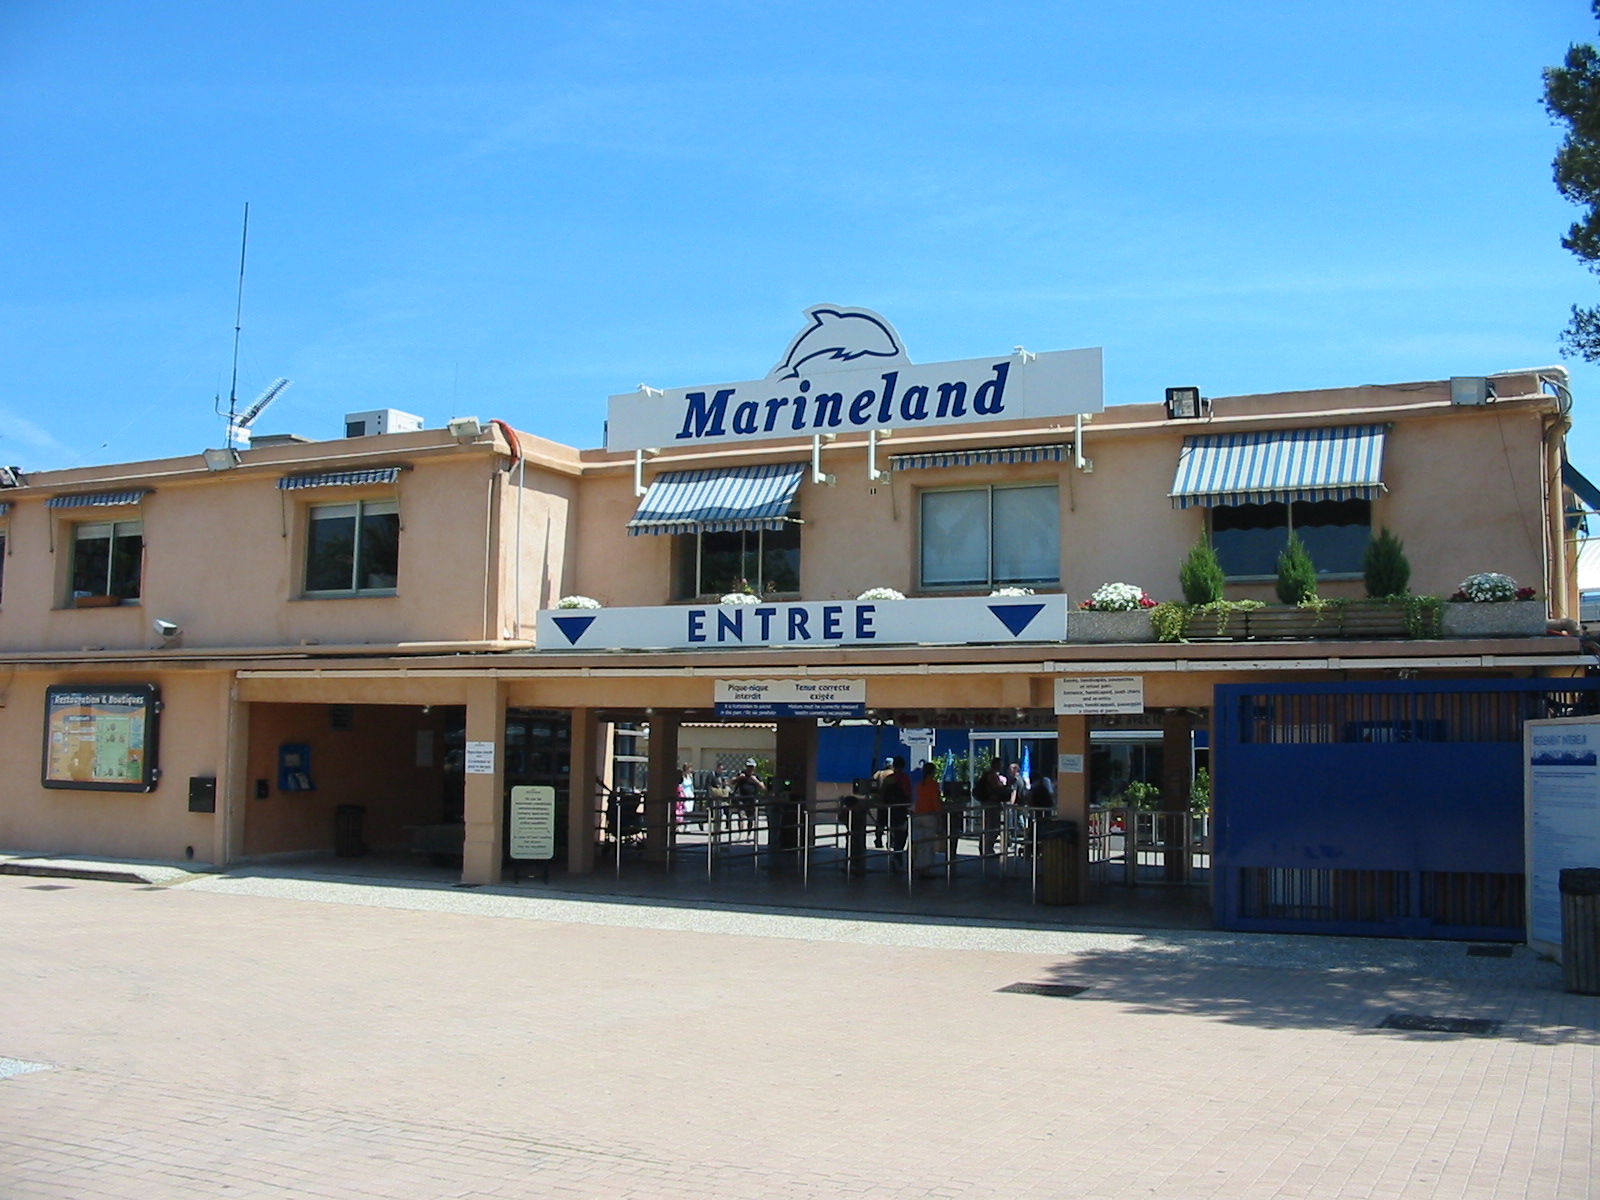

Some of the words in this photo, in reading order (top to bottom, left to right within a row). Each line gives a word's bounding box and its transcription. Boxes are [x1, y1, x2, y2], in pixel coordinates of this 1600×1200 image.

[675, 362, 1010, 439] Marineland
[688, 605, 877, 643] ENTREE
[728, 684, 769, 692] Pique-nique
[818, 684, 851, 692] correcte
[54, 695, 100, 704] Restauration
[108, 694, 144, 706] Boutiques
[809, 692, 835, 701] exigée
